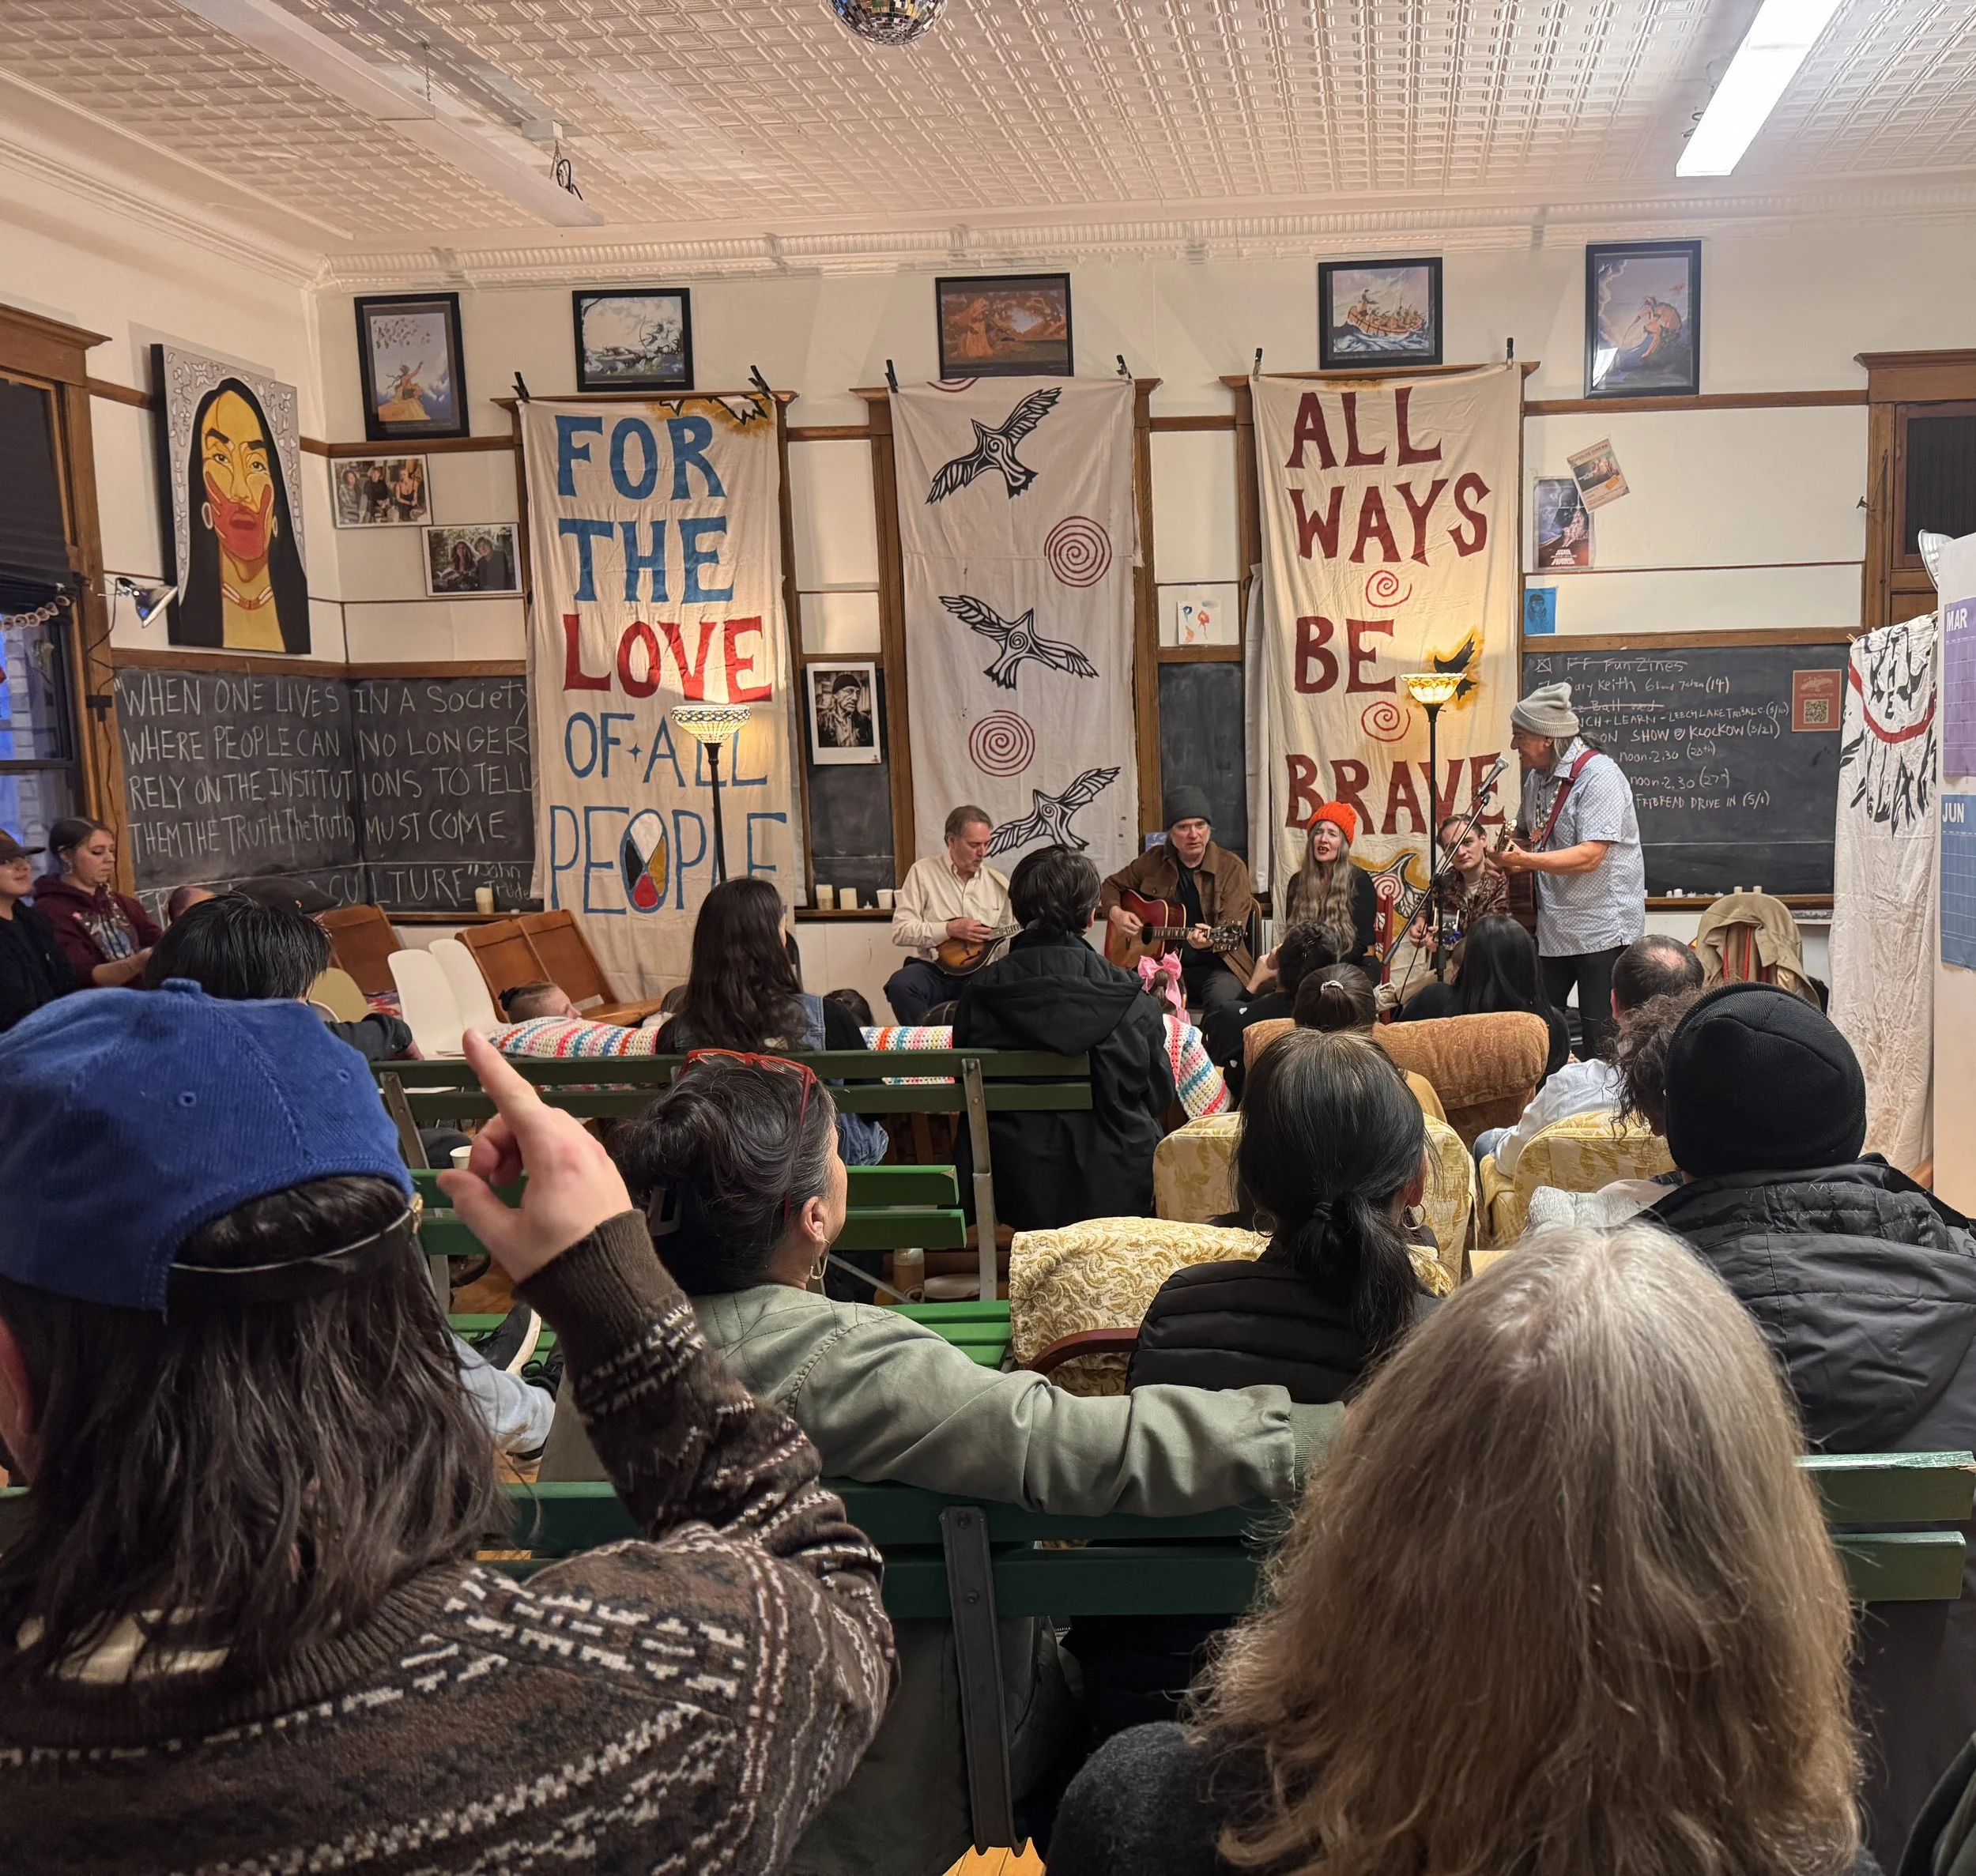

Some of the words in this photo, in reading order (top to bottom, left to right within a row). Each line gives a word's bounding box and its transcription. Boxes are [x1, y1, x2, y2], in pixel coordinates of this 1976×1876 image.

[1284, 386, 1442, 470] ALL
[554, 415, 727, 501] FOR
[1286, 472, 1491, 567] WAYS
[558, 515, 734, 605] THE
[1946, 607, 1967, 632] MAR
[563, 613, 772, 704] LOVE
[1295, 616, 1397, 695] BE
[214, 678, 264, 714] ONE
[277, 680, 339, 718] LIVES
[351, 682, 389, 714] IN
[399, 687, 416, 716] A
[1597, 676, 1636, 693] Keith
[1706, 676, 1729, 694] (14)
[123, 725, 204, 765] WHERE
[213, 723, 292, 760] PEOPLE
[296, 729, 340, 758] CAN
[359, 729, 396, 762] NO
[406, 725, 529, 756] LONGER
[564, 711, 635, 778] OF
[643, 714, 767, 788] ALL
[1631, 729, 1669, 743] SHOW
[1689, 723, 1744, 740] KLOCKOW
[128, 774, 185, 811] RELY
[194, 775, 221, 804] ON
[222, 770, 266, 802] THE
[432, 767, 470, 797] TO
[473, 762, 533, 795] TELL
[1285, 752, 1507, 834] BRAVE
[1690, 797, 1721, 811] DRIVE
[1726, 795, 1737, 807] IN
[1941, 802, 1965, 823] JUN
[127, 821, 183, 865] THEM
[182, 819, 221, 856] THE
[221, 809, 281, 856] TRUTH
[365, 812, 420, 845] MUST
[429, 808, 507, 846] COME
[483, 880, 531, 901] Trude
